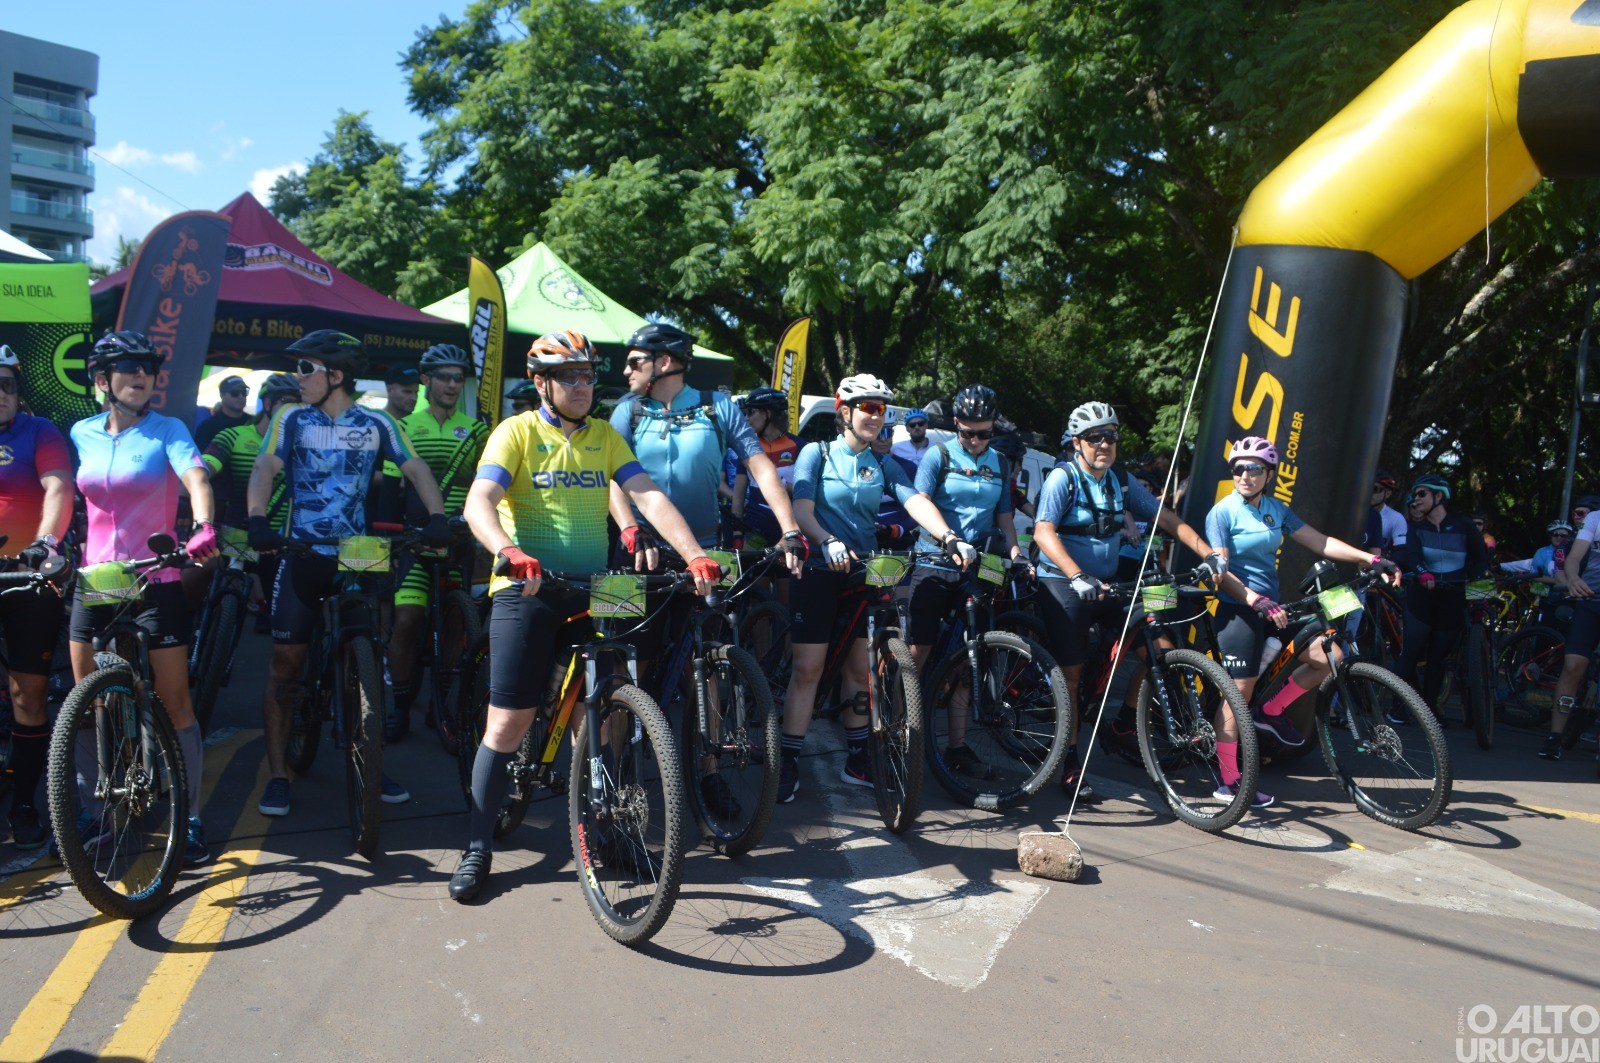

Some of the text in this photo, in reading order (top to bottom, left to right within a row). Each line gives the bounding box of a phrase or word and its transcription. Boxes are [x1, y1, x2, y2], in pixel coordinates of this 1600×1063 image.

[3, 284, 55, 298] SUA IDEIA.
[151, 298, 182, 361] Bike
[250, 319, 262, 337] &
[266, 319, 304, 339] Bike
[363, 333, 382, 347] (55)
[532, 470, 608, 489] BRASIL
[593, 603, 645, 612] CICLOURISMO
[1157, 678, 1176, 730] MANITOU
[1186, 674, 1204, 717] MANITO
[551, 725, 563, 746] 7.2
[1374, 811, 1405, 824] KENDA
[578, 823, 599, 889] ALEXRIMS
[600, 913, 625, 935] KENDA
